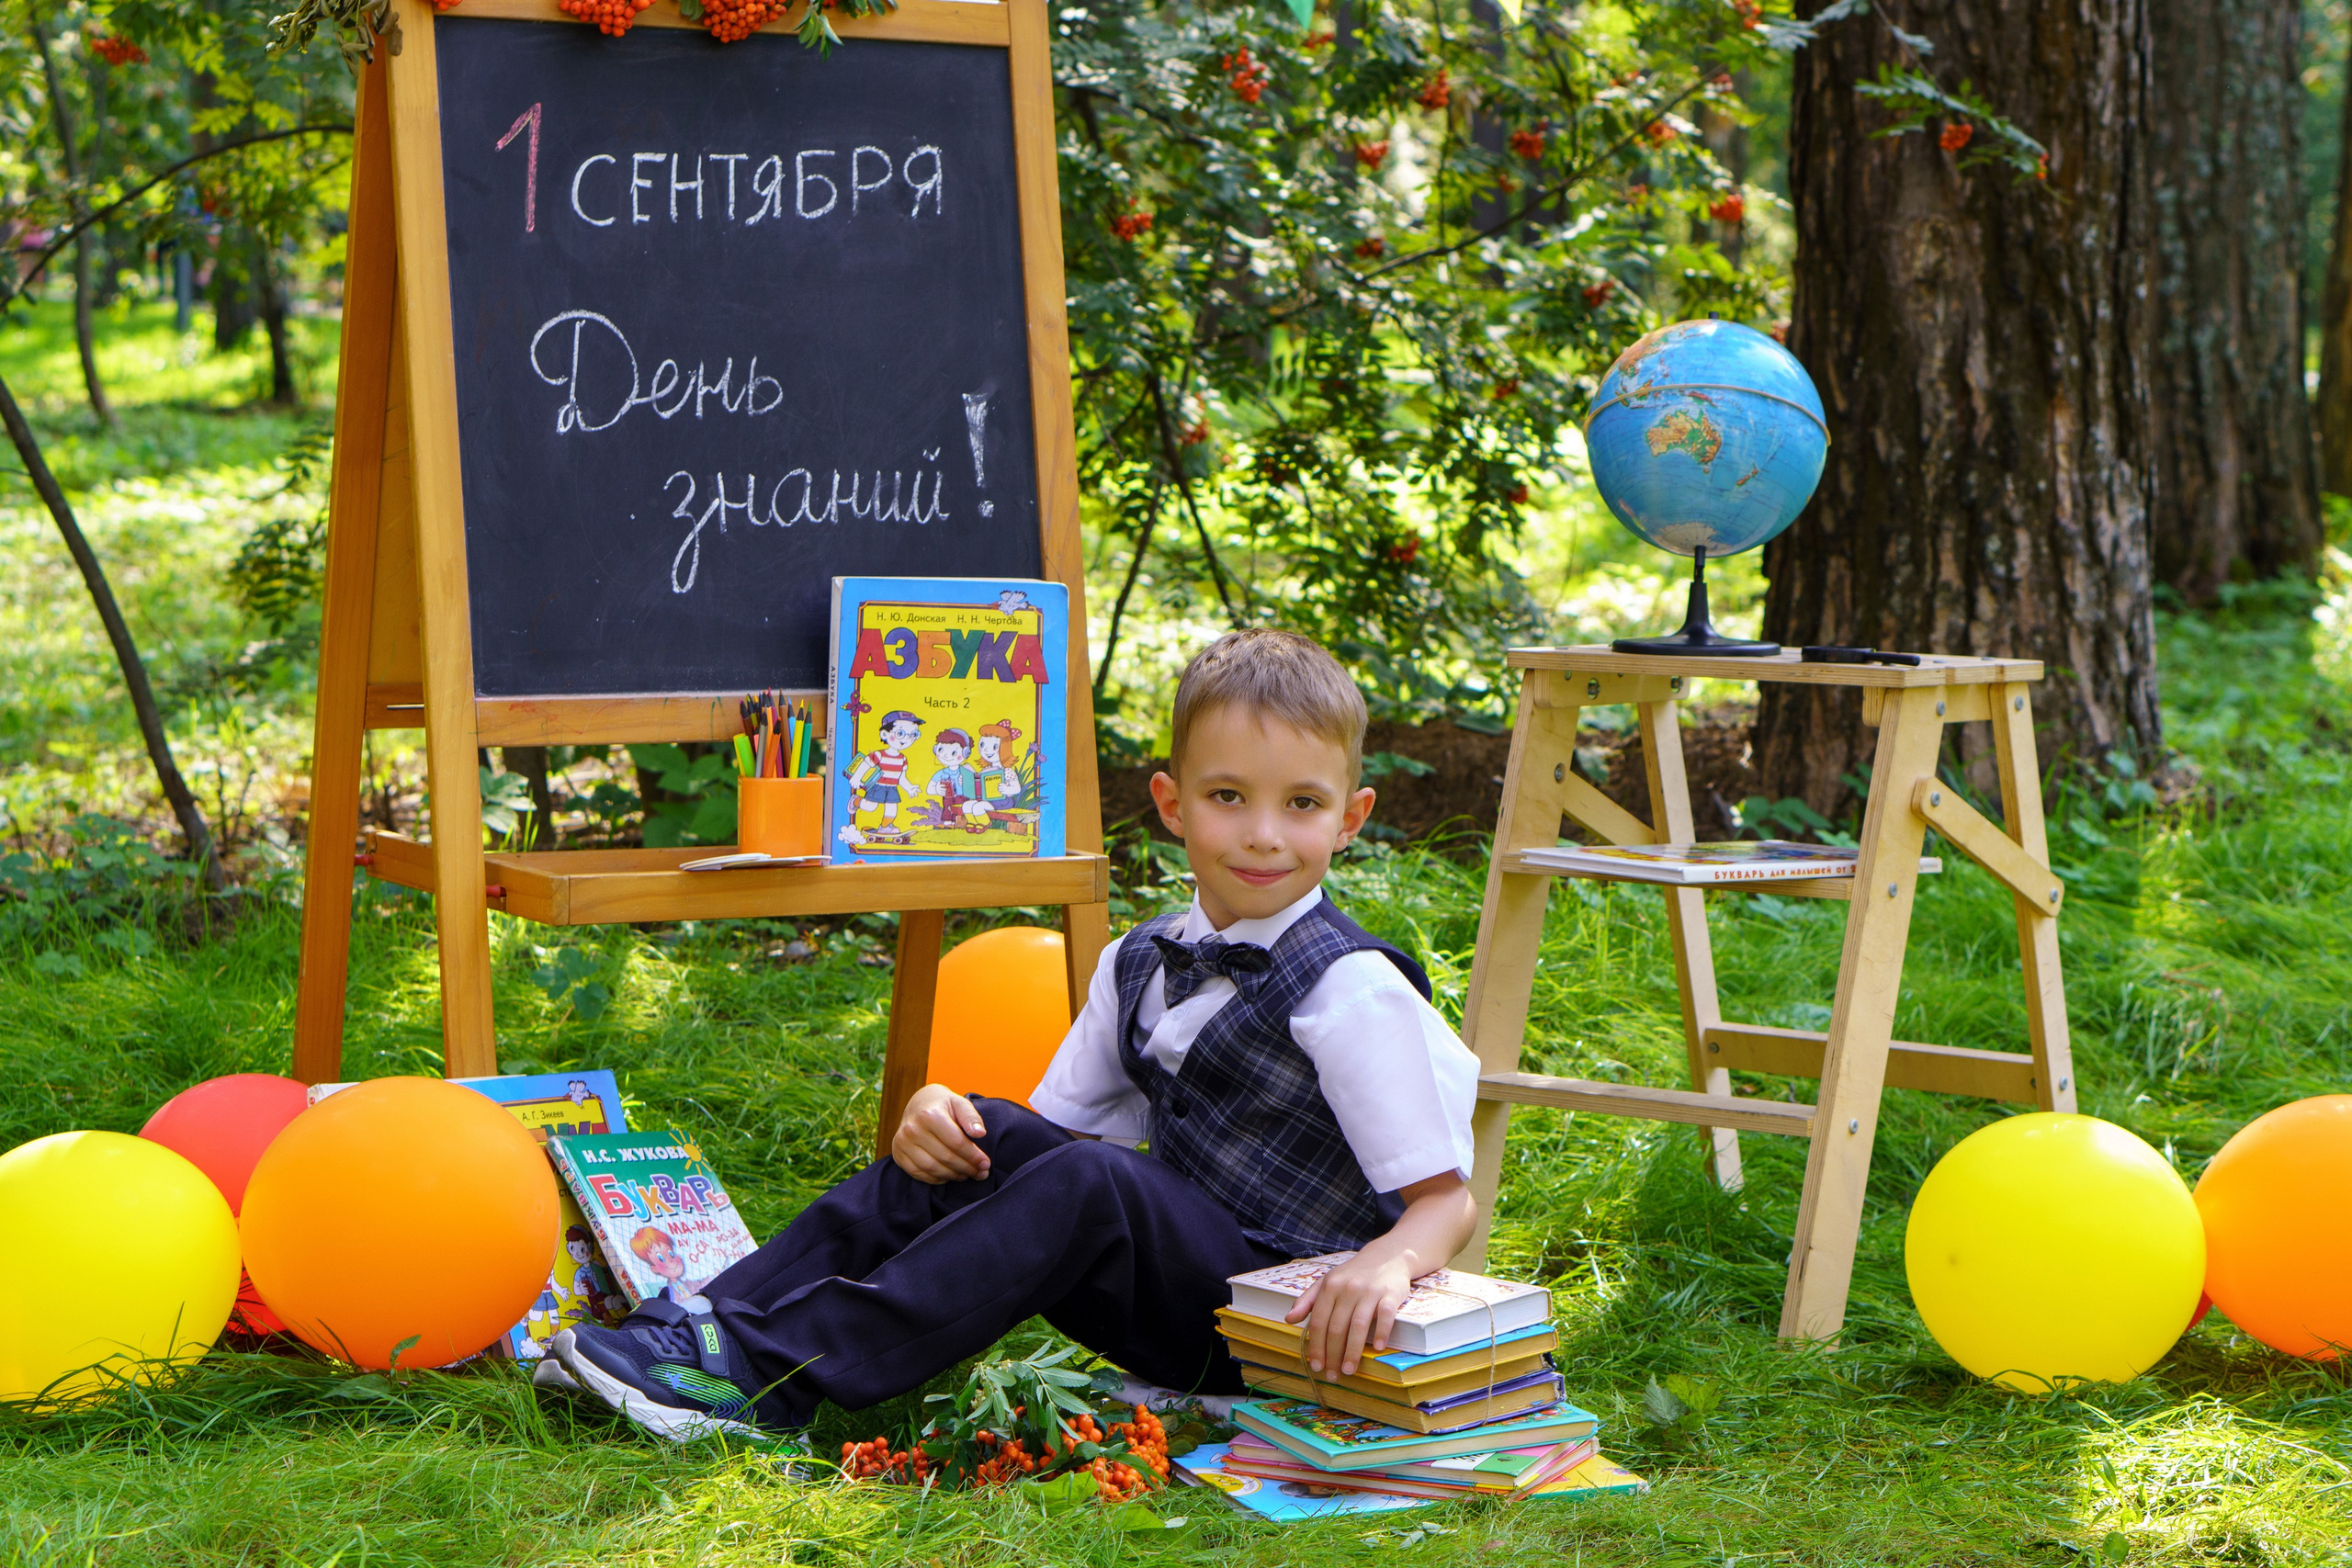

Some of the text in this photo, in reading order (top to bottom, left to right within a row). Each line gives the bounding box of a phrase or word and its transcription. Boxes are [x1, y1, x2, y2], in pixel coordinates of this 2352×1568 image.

[495, 102, 943, 232] 1 СЕНТЯБРЯ
[530, 310, 784, 434] День
[876, 612, 1023, 626] Н. Ю. Донская Н. Н. Чертова
[849, 626, 1049, 684] АЗБУКА
[924, 696, 970, 709] Часть 2
[1714, 870, 1765, 880] БУКВАРЬ
[522, 1109, 565, 1121] А. Г. Зикеев
[582, 1145, 691, 1164] Н.С. ЖУКОВА
[560, 1158, 607, 1241] БУКВАРЬ
[586, 1173, 731, 1223] БУКВАРЬ
[667, 1219, 720, 1235] МА-МА
